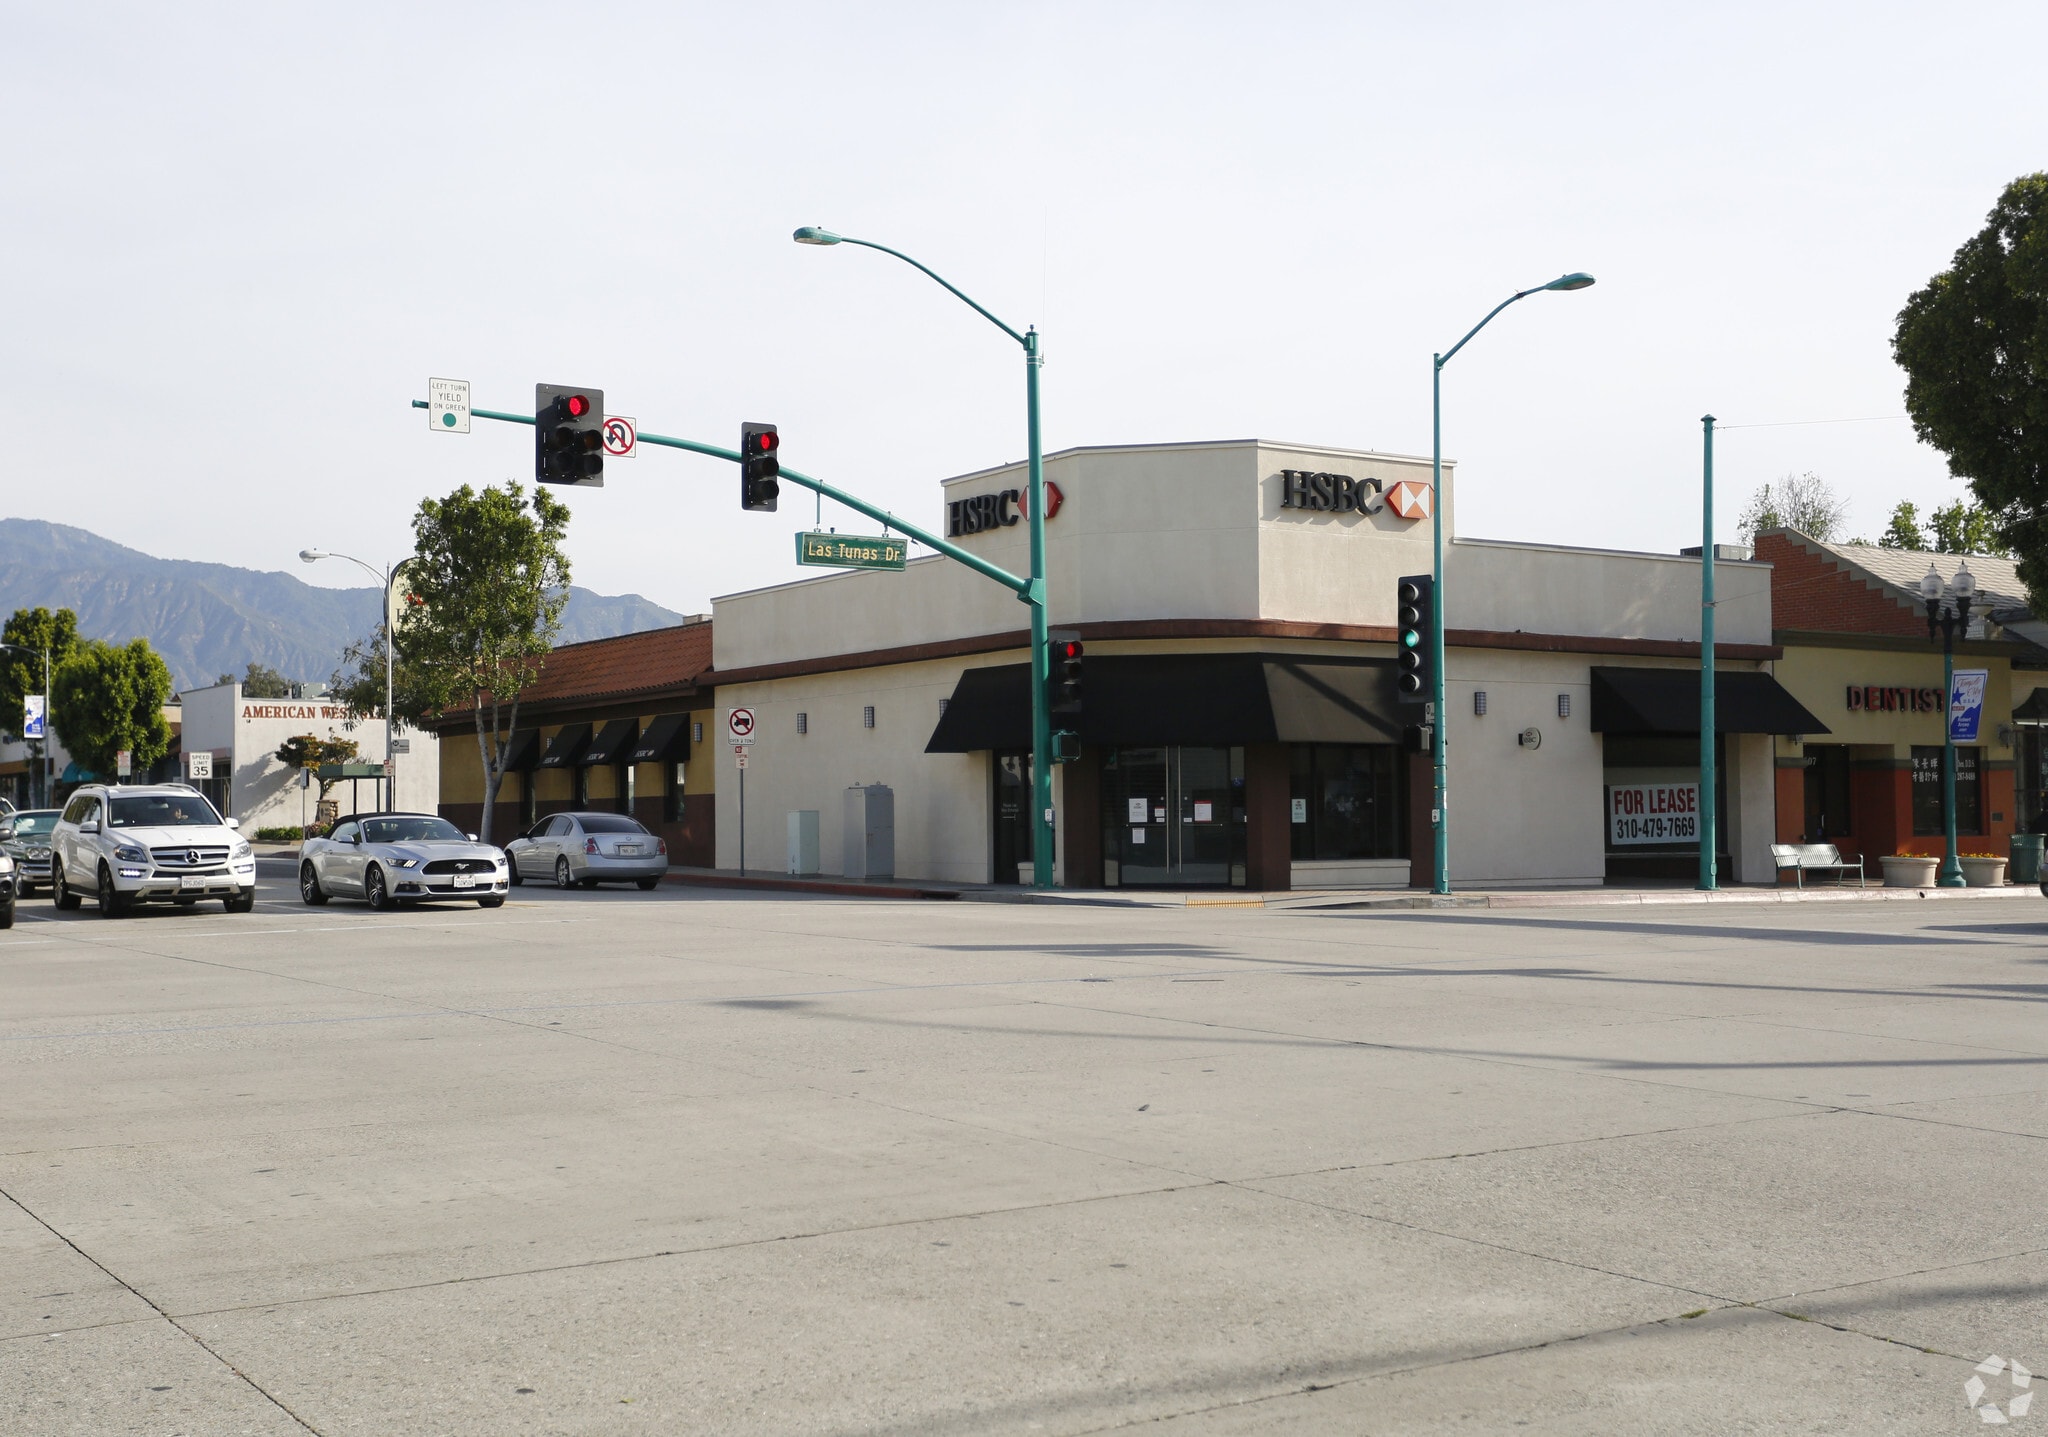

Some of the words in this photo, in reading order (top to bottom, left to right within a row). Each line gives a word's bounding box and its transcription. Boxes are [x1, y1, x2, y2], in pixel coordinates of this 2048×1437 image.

[432, 382, 447, 391] LEFT
[450, 384, 467, 393] TURN
[438, 392, 461, 402] YIELD
[434, 402, 443, 410] ON
[445, 404, 466, 412] GREEN
[1280, 469, 1383, 516] HSBC
[947, 489, 1019, 538] HSBC
[808, 541, 832, 558] Las
[838, 543, 878, 561] Tunas
[885, 546, 900, 562] Dr
[1846, 686, 1945, 713] DENTIST
[242, 705, 316, 719] AMERICAN
[193, 766, 209, 776] 35
[1614, 789, 1644, 815] FOR
[1648, 788, 1696, 814] LEASE
[1616, 816, 1695, 839] 310-479-7669
